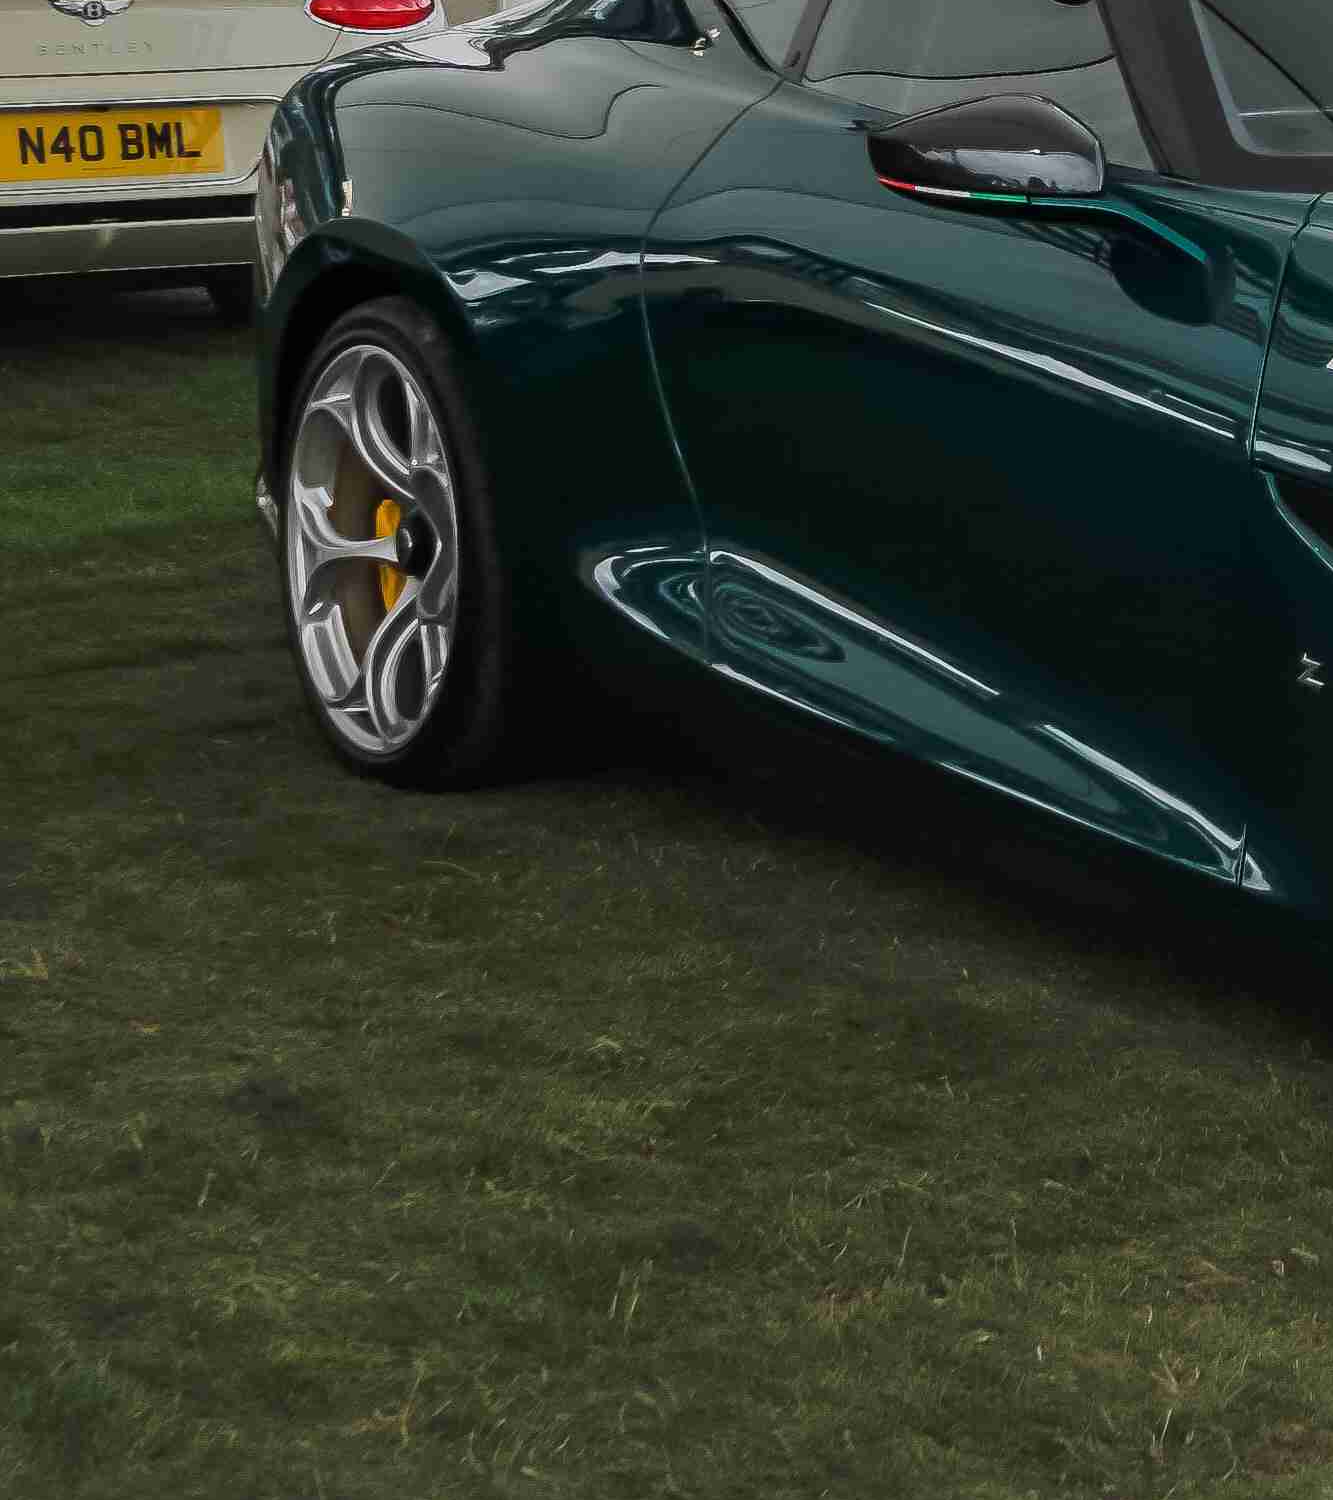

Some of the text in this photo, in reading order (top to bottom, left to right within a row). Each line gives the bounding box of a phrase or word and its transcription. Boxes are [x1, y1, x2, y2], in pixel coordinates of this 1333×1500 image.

[39, 39, 153, 56] BENTLEY
[18, 121, 202, 165] N40 BML
